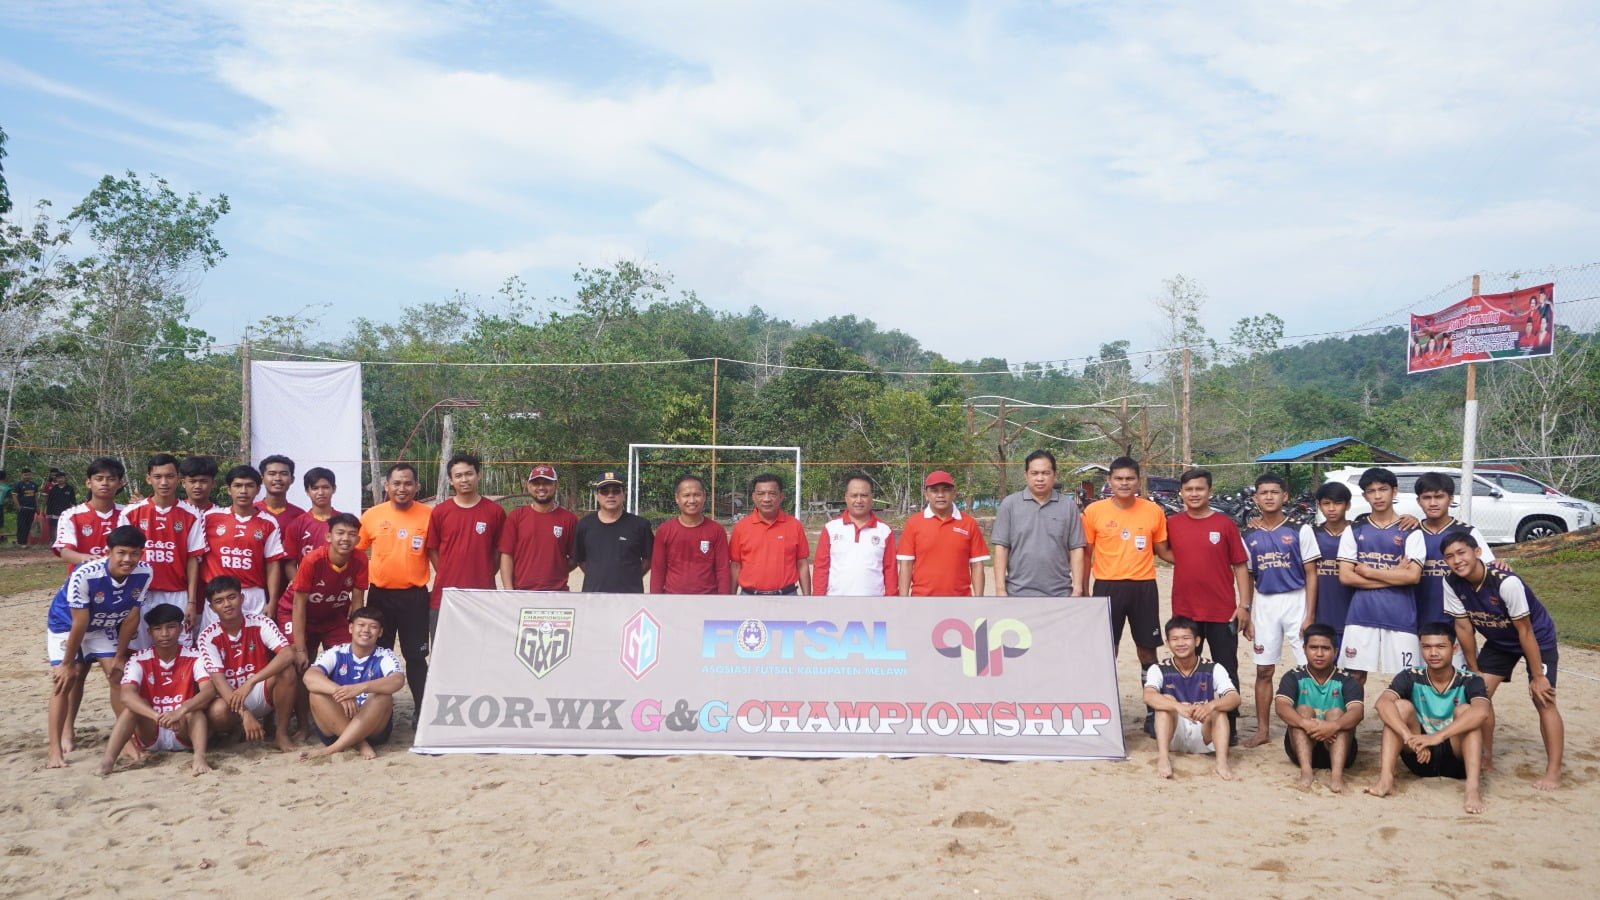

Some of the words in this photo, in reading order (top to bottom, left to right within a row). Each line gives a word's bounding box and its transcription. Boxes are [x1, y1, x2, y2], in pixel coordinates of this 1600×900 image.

[145, 540, 175, 549] G&G
[146, 550, 174, 562] RBS
[220, 547, 252, 557] G&G
[221, 556, 252, 569] RBS
[702, 620, 906, 660] FUTSAL
[1401, 652, 1413, 667] 12
[225, 663, 256, 678] G&G
[701, 664, 752, 675] ASOSIASI
[755, 665, 794, 675] FUTSAL
[797, 665, 860, 676] KABUPATEN
[864, 666, 908, 676] MELAWI
[153, 694, 183, 703] G&G
[429, 694, 627, 730] KOR-WK
[735, 699, 1112, 737] CHAMPIONSHIP
